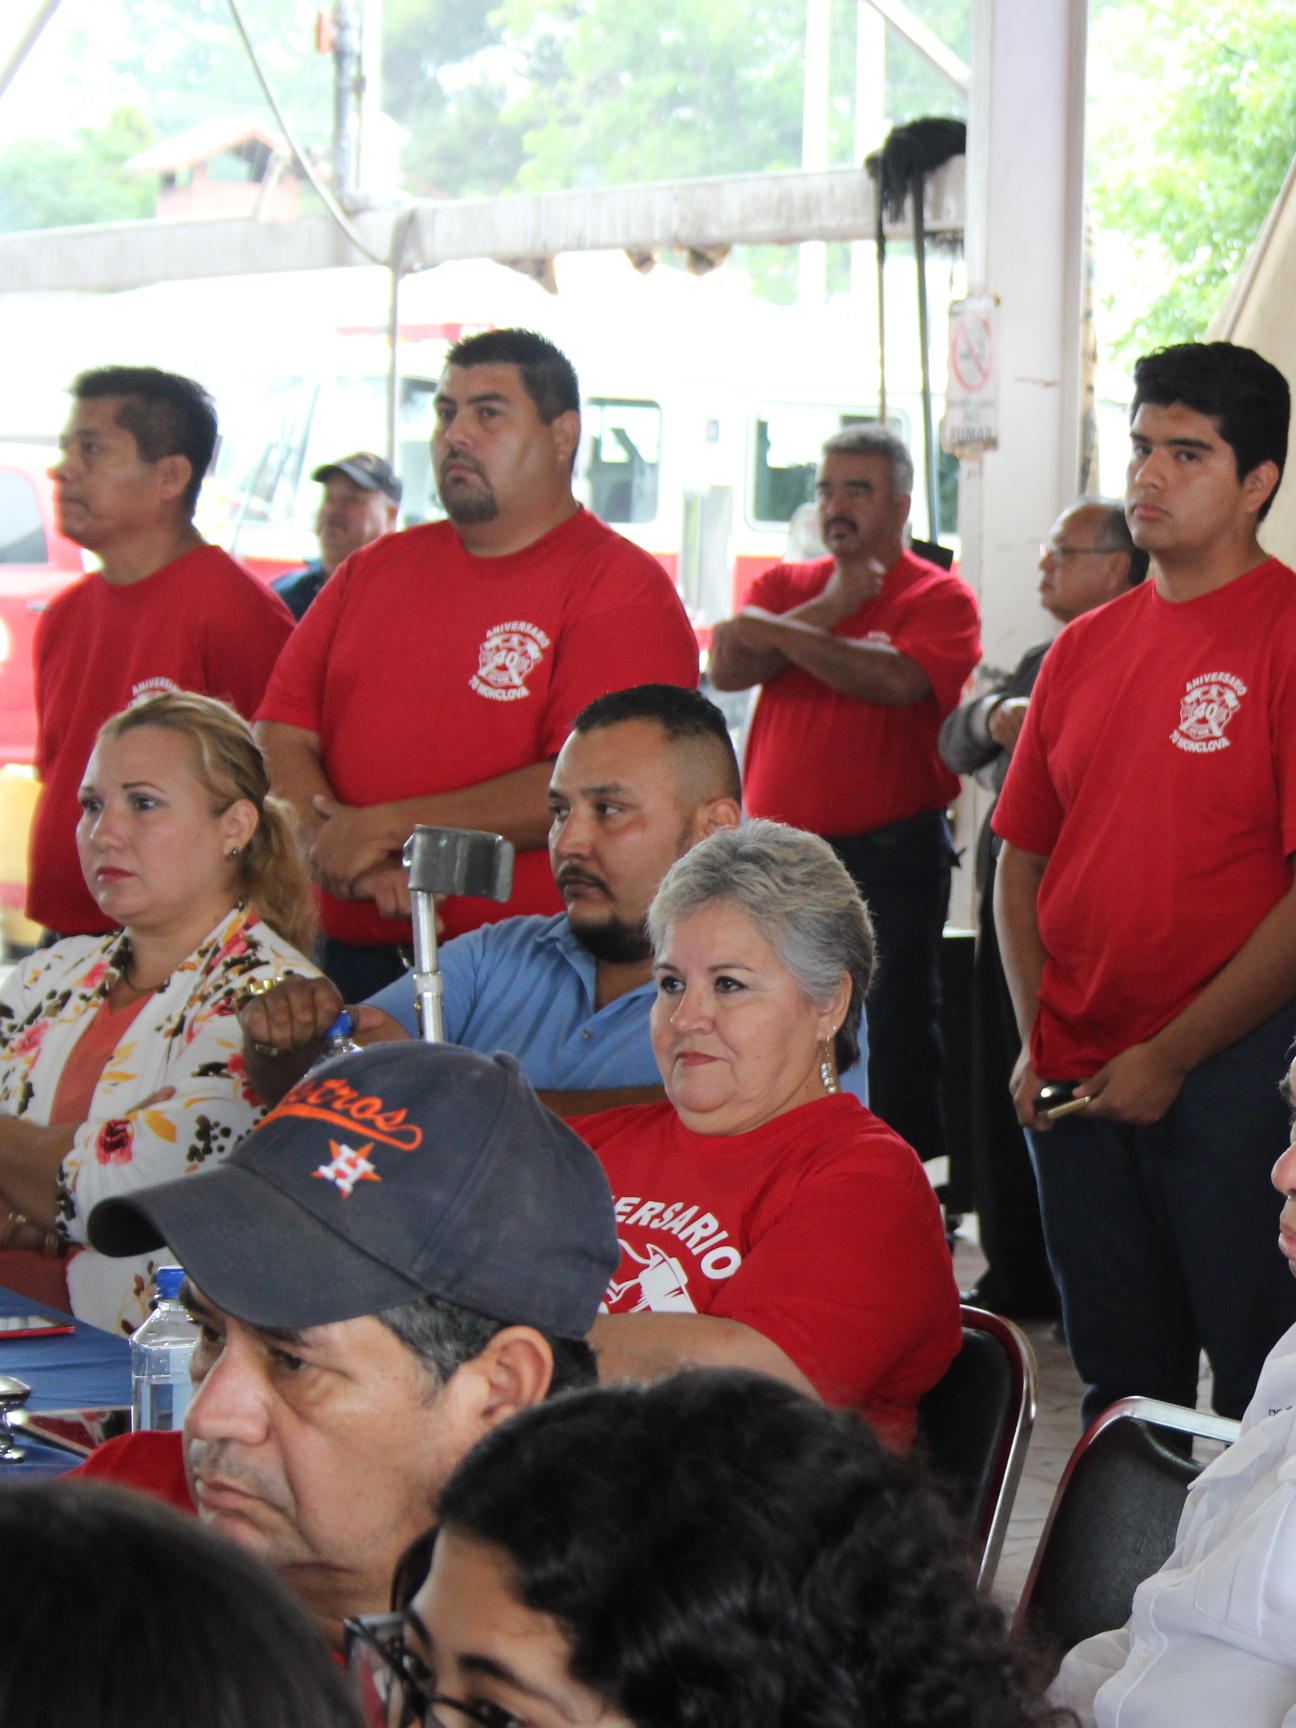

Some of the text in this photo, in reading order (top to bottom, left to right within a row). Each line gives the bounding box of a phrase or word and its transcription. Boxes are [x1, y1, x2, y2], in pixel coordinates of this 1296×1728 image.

[486, 621, 551, 649] ANIVERSARIO
[492, 650, 519, 669] 40
[477, 684, 530, 701] MONCLOVA
[1186, 671, 1248, 697] ANIVERSARIO
[1193, 701, 1219, 720] 40
[1176, 736, 1231, 753] MONCLOVA
